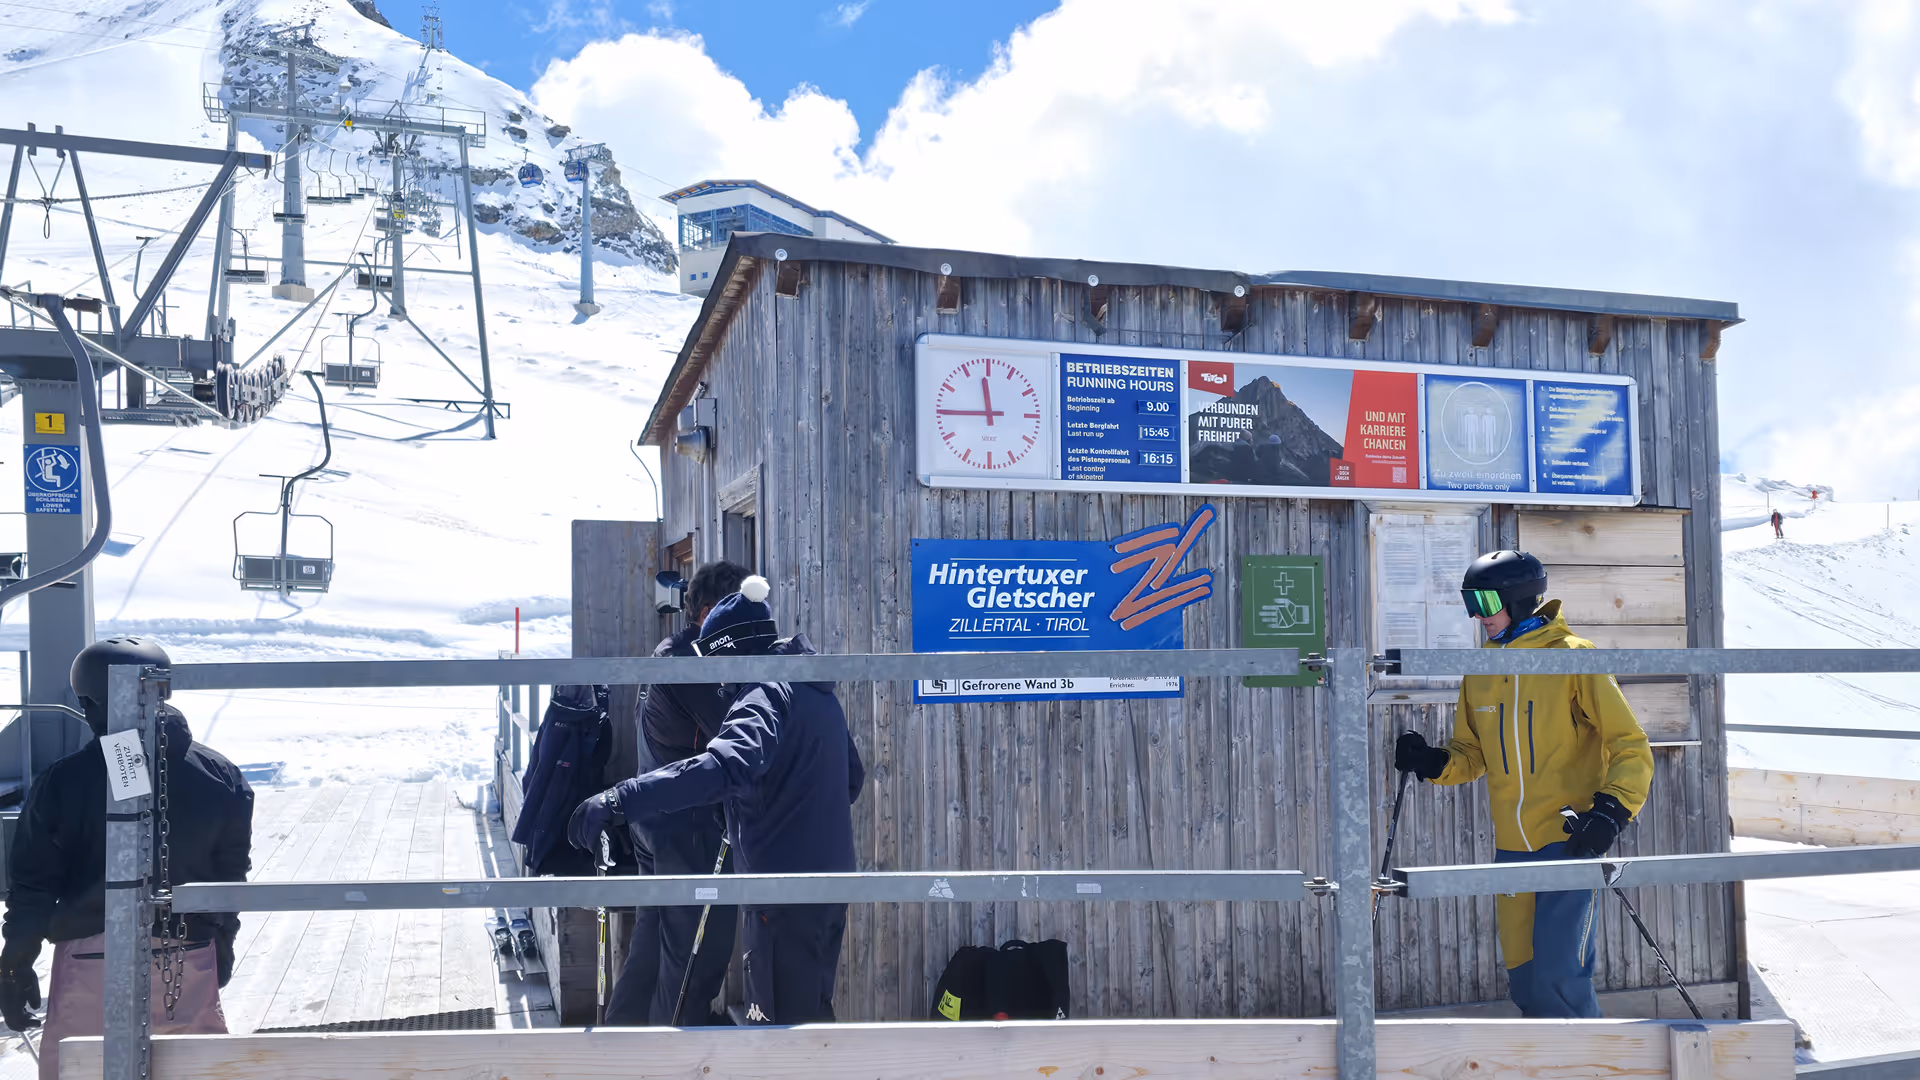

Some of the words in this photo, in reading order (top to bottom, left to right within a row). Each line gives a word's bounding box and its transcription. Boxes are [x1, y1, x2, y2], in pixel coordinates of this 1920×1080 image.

[1066, 362, 1173, 377] BETRIEBSZEITEN
[1068, 377, 1126, 389] RUNNING
[1130, 380, 1174, 392] HOURS
[1201, 373, 1227, 384] Tirol
[1147, 402, 1169, 412] 9.00
[1199, 402, 1258, 415] VERBUNDEN
[45, 415, 52, 428] 1
[1198, 416, 1218, 427] MIT
[1221, 417, 1253, 429] PURER
[1366, 411, 1385, 422] UND
[1388, 412, 1406, 423] MIT
[1144, 428, 1169, 437] 15:45
[1198, 430, 1240, 442] FREIHEIT
[1360, 424, 1405, 436] KARRIERE
[1364, 438, 1405, 450] CHANCEN
[1144, 453, 1173, 464] 16:15
[1477, 471, 1521, 480] einordnen
[928, 563, 1088, 585] Hintertuxer
[967, 586, 1095, 608] Gletscher
[949, 618, 1031, 632] ZILLERTAL
[1045, 617, 1090, 632] TIROL
[962, 681, 1020, 690] Gefrorene
[1025, 679, 1056, 689] Wand
[1061, 679, 1074, 688] 3b
[114, 743, 129, 788] VERBOTEN
[124, 746, 136, 780] ZUTRITT
